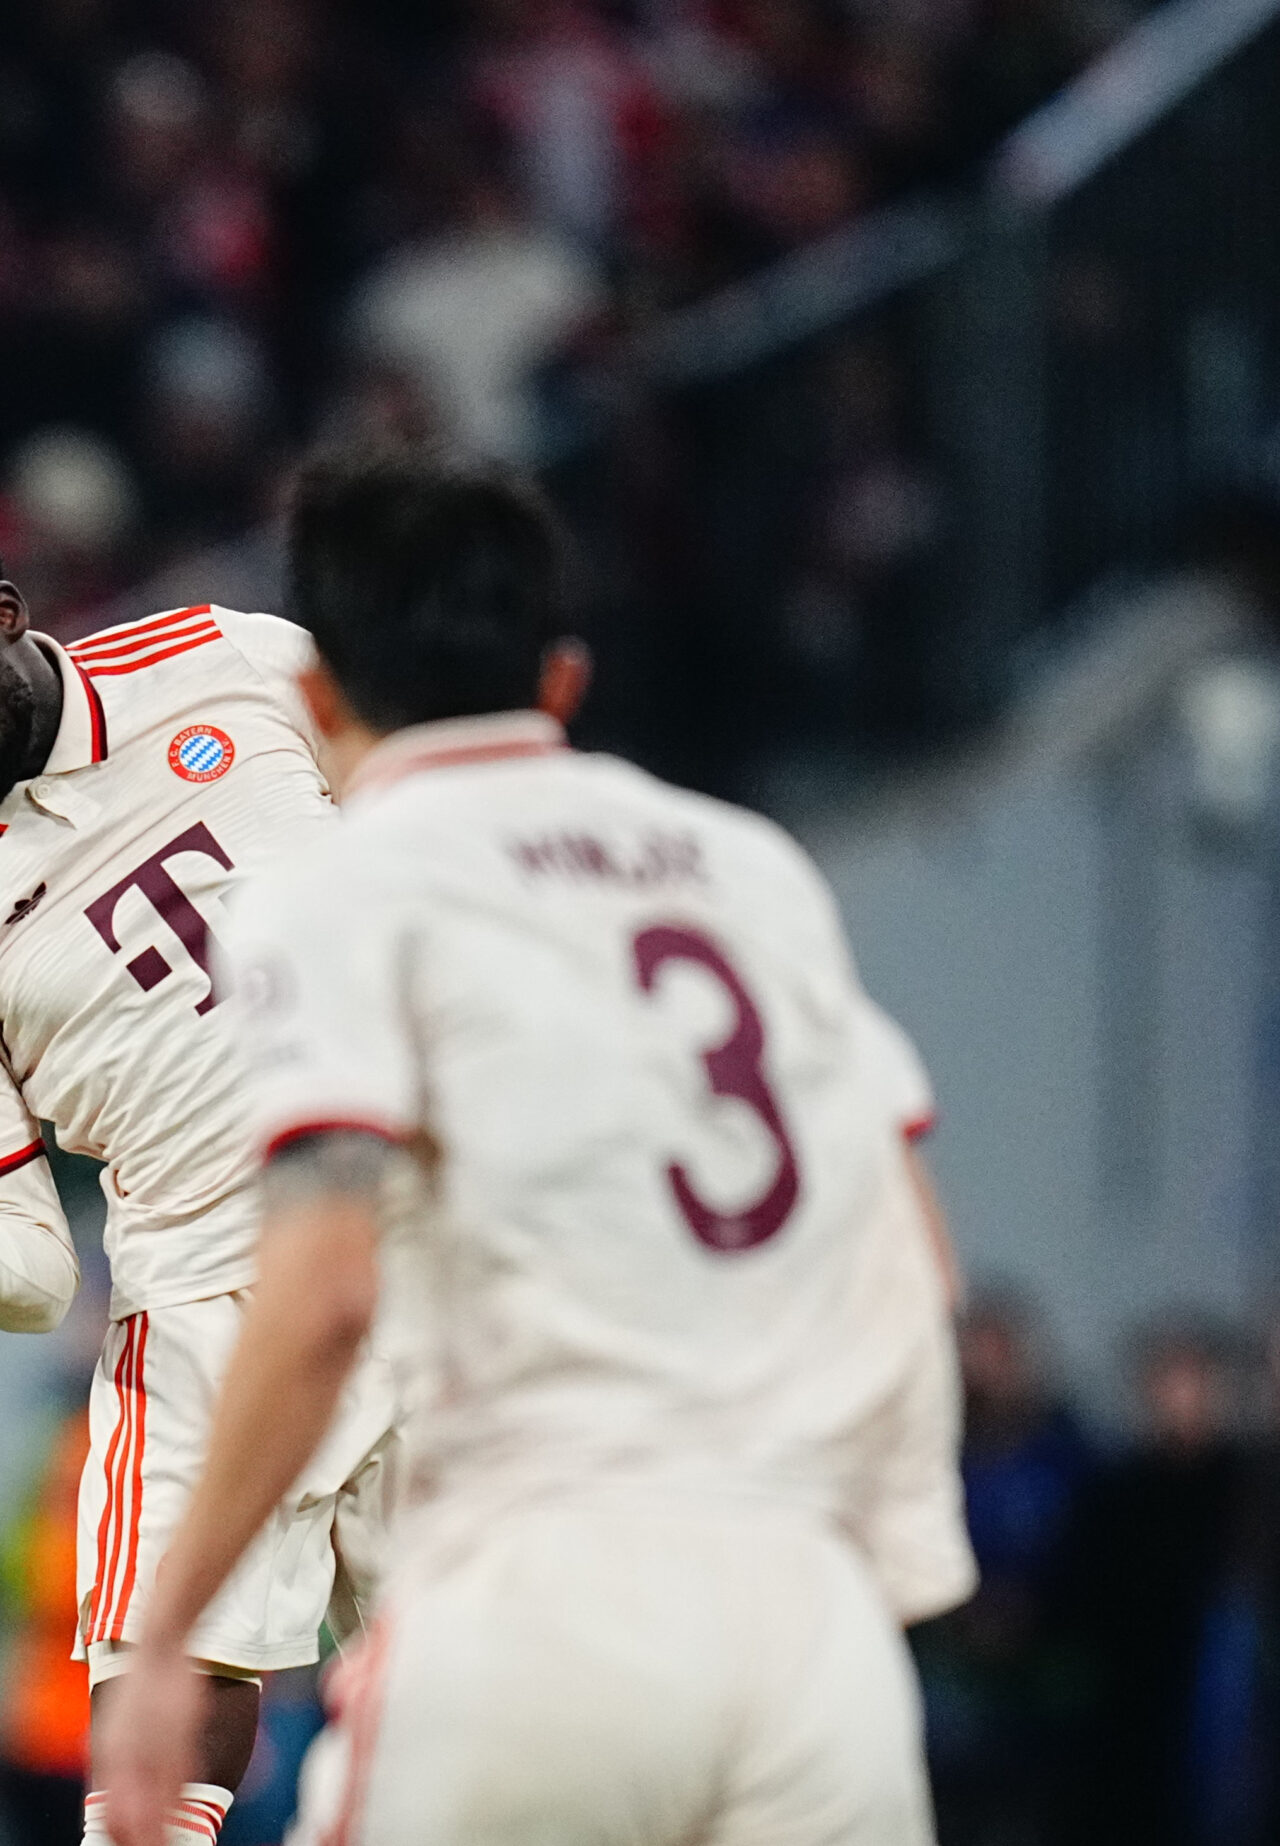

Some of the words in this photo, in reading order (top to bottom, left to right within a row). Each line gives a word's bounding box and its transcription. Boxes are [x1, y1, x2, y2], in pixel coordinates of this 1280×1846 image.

[173, 725, 213, 746] BAYERN
[83, 820, 236, 1017] T
[632, 926, 800, 1252] 3
